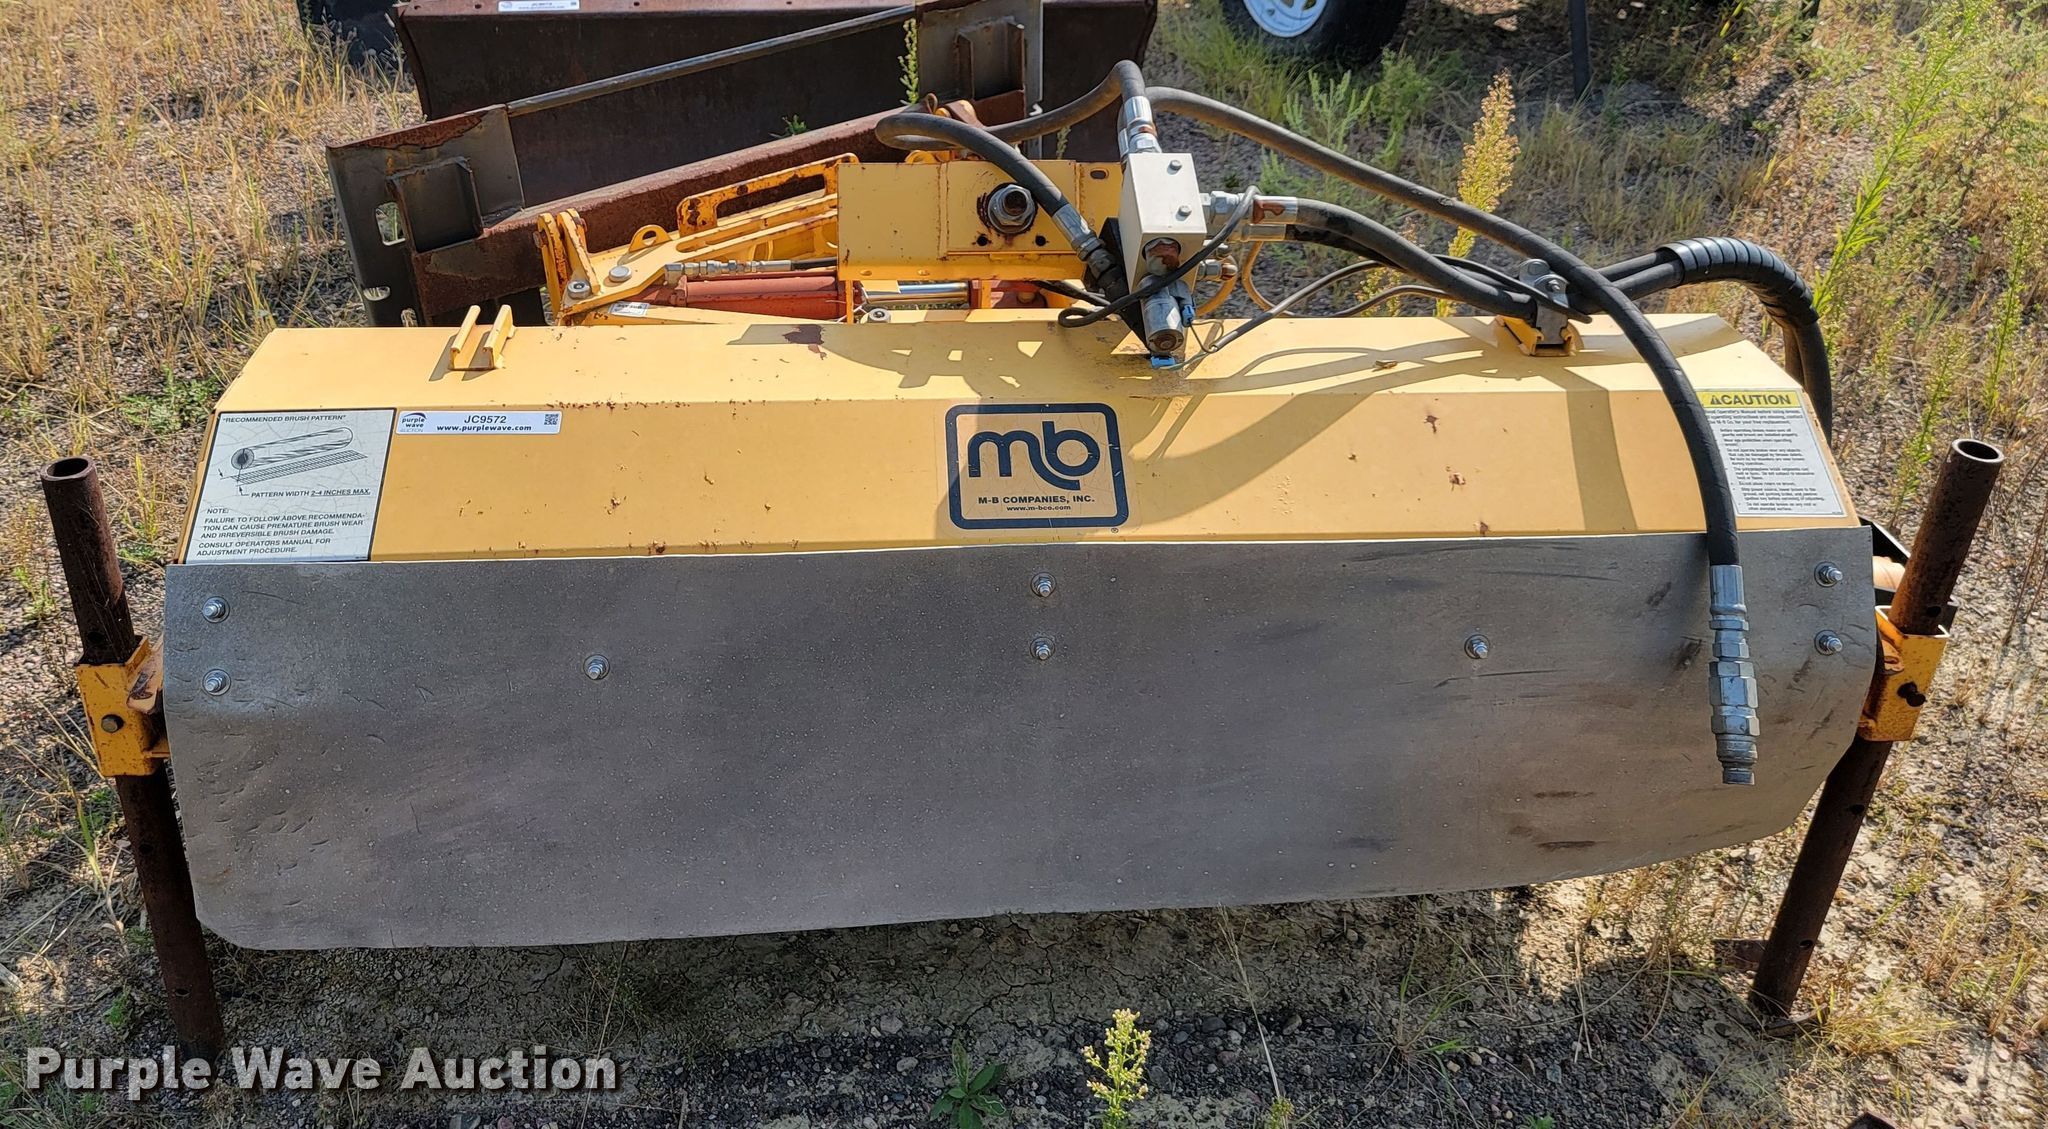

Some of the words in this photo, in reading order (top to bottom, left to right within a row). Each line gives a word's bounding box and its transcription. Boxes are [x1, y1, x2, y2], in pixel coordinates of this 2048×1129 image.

[1720, 394, 1791, 405] CAUTION
[223, 415, 282, 423] "RECOMMENDED
[464, 415, 507, 424] JC9572
[436, 424, 531, 432] www.purplewave.com
[968, 421, 1100, 490] mb
[251, 490, 284, 498] PATTERN
[1003, 495, 1070, 504] COMPANIES,
[1072, 495, 1095, 503] INC.
